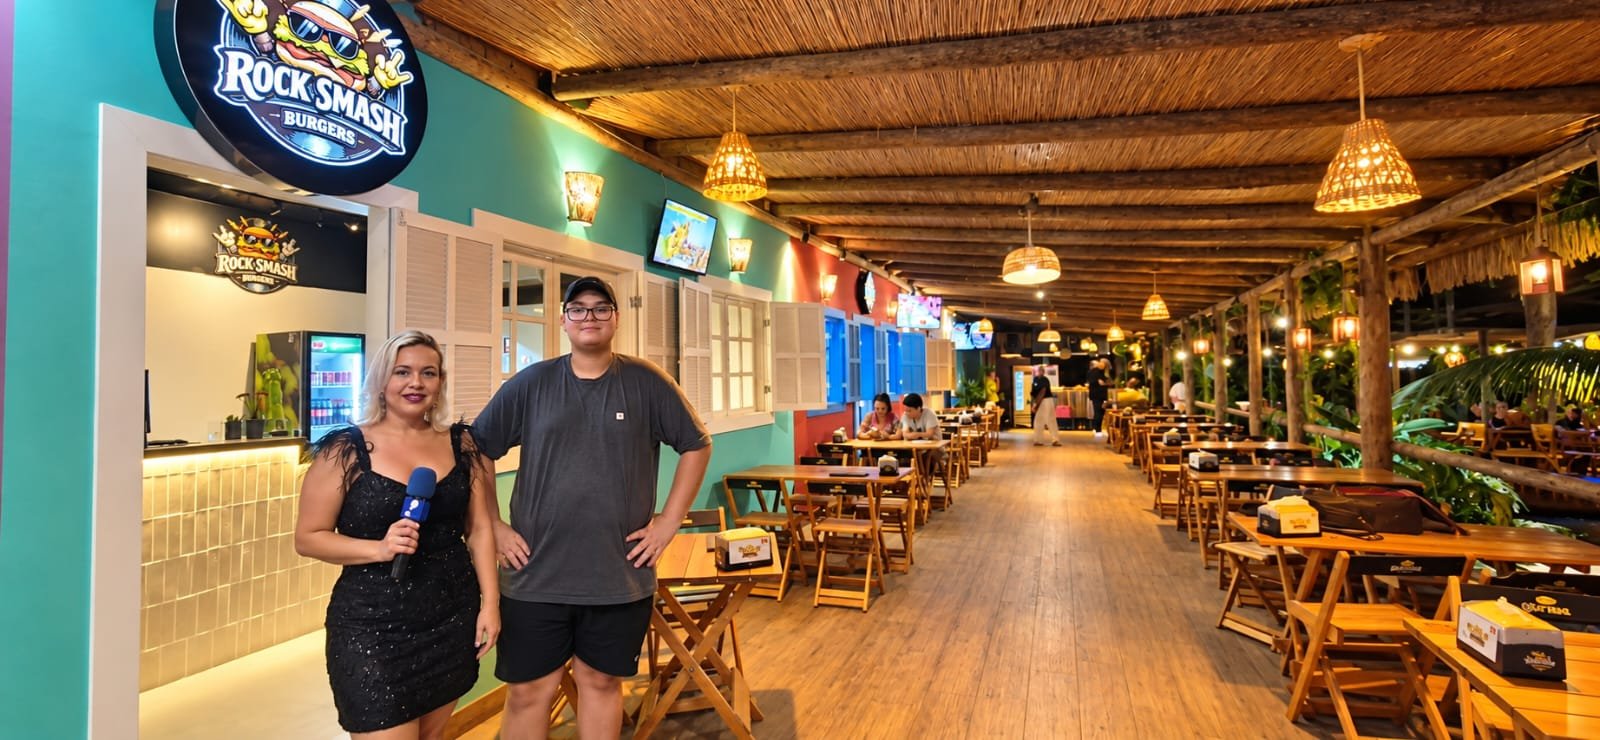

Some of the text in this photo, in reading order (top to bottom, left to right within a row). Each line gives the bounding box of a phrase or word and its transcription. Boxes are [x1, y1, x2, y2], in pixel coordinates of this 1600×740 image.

[222, 50, 402, 146] ROCK SMASH
[284, 110, 356, 146] BURGERS
[217, 254, 297, 280] ROCK SMASH
